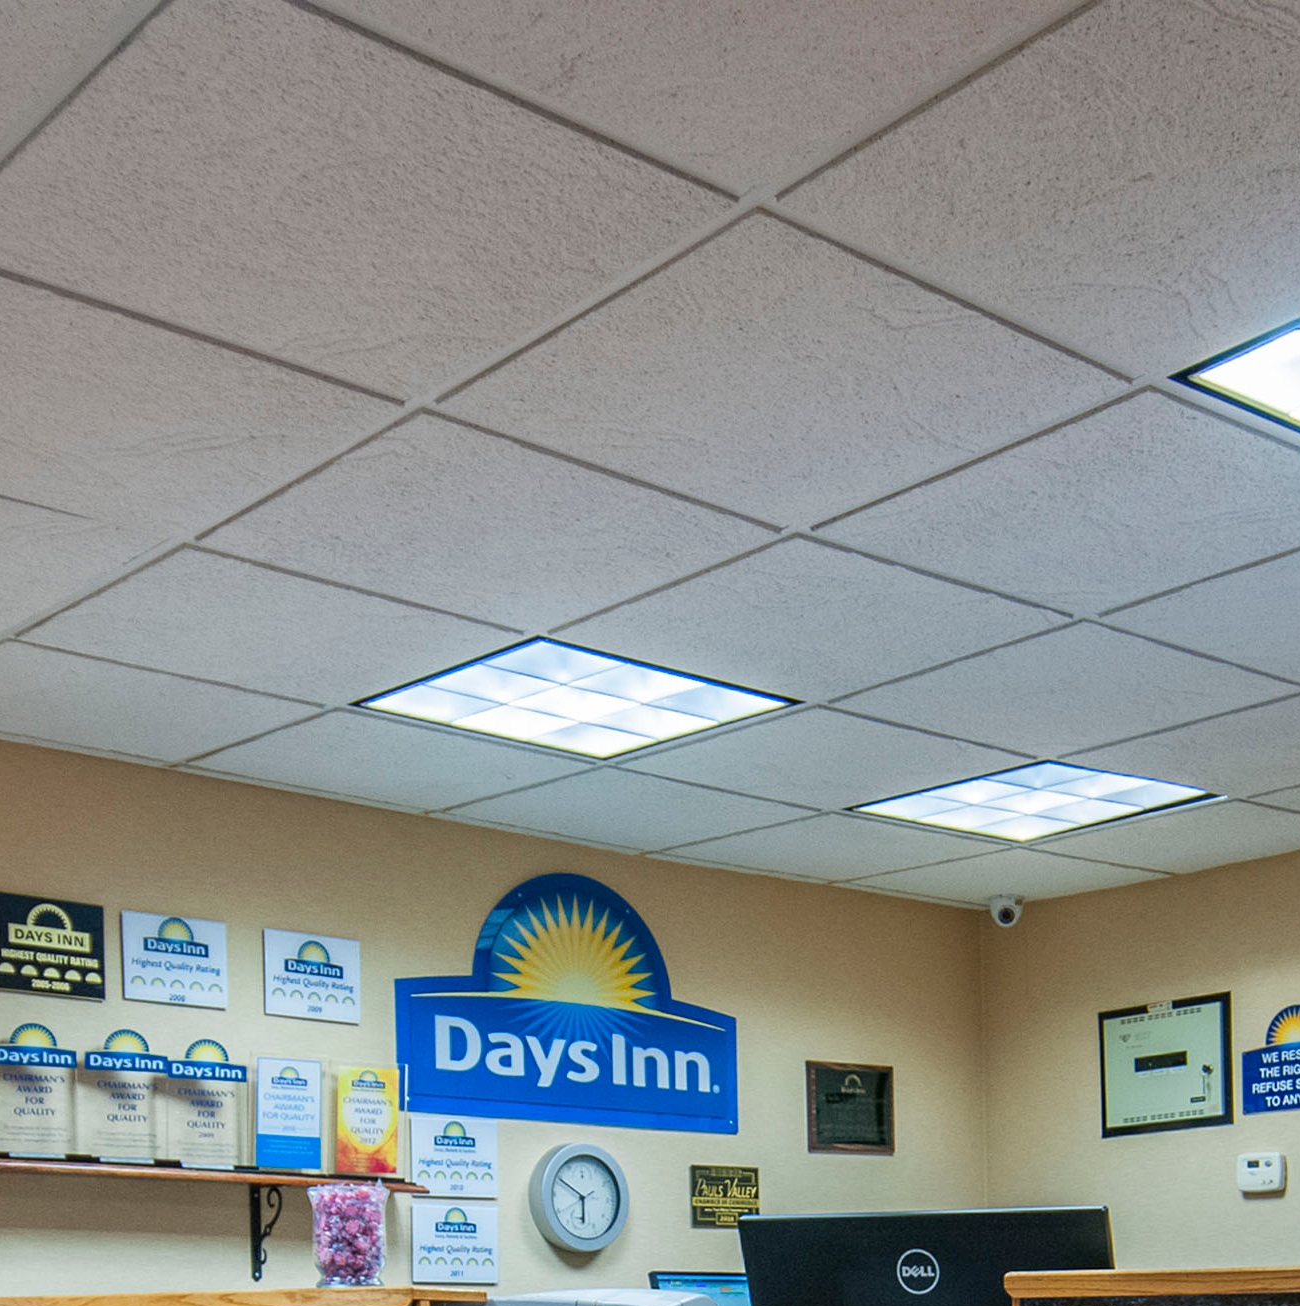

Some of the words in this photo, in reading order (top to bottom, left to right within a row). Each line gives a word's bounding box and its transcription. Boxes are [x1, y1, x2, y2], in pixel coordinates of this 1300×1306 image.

[14, 928, 53, 943] DAYS
[57, 934, 84, 947] INN
[147, 938, 181, 953] Days
[182, 942, 206, 955] Inn
[131, 957, 162, 968] Highest
[164, 960, 194, 973] Quality
[195, 964, 221, 977] Rating
[287, 960, 319, 974] Days
[319, 964, 340, 976] Inn
[272, 974, 301, 985] Highest
[302, 977, 329, 989] Quality
[331, 982, 354, 994] Rating
[42, 1051, 72, 1065] Inn
[434, 1014, 600, 1087] Days
[612, 1033, 711, 1093] Inn
[1261, 1052, 1279, 1064] WE
[89, 1054, 132, 1069] Days
[134, 1057, 164, 1070] Inn
[171, 1063, 213, 1077] Days
[214, 1066, 242, 1079] Inn
[1259, 1066, 1280, 1078] THE
[2, 1072, 65, 1083] CHAIRMAN'S
[16, 1085, 53, 1094] AWARD
[97, 1080, 159, 1091] CHAIRMAN'S
[1252, 1079, 1293, 1094] REFUSE
[110, 1092, 145, 1101] AWARD
[177, 1088, 236, 1098] CHAIRMAN'S
[25, 1096, 45, 1104] FOR
[190, 1099, 223, 1108] AWARD
[1265, 1096, 1280, 1107] TO
[13, 1107, 55, 1116] QUALITY
[118, 1103, 137, 1111] FOR
[273, 1103, 305, 1111] AWARD
[353, 1107, 383, 1115] AWARD
[107, 1113, 147, 1122] QUALITY
[197, 1110, 216, 1118] FOR
[262, 1111, 278, 1119] FOR
[281, 1112, 315, 1120] QUALITY
[187, 1120, 226, 1129] QUALITY
[350, 1127, 384, 1135] QUALITY
[436, 1137, 458, 1146] Days
[459, 1138, 473, 1146] Inn
[418, 1159, 444, 1167] Highest
[446, 1159, 469, 1168] Quality
[471, 1160, 492, 1169] Rating
[725, 1178, 757, 1198] VALLEY
[437, 1222, 458, 1232] Days
[459, 1224, 474, 1232] Inn
[419, 1245, 444, 1254] Highest
[446, 1245, 470, 1254] Quality
[472, 1246, 493, 1255] Rating
[902, 1265, 935, 1278] DELL
